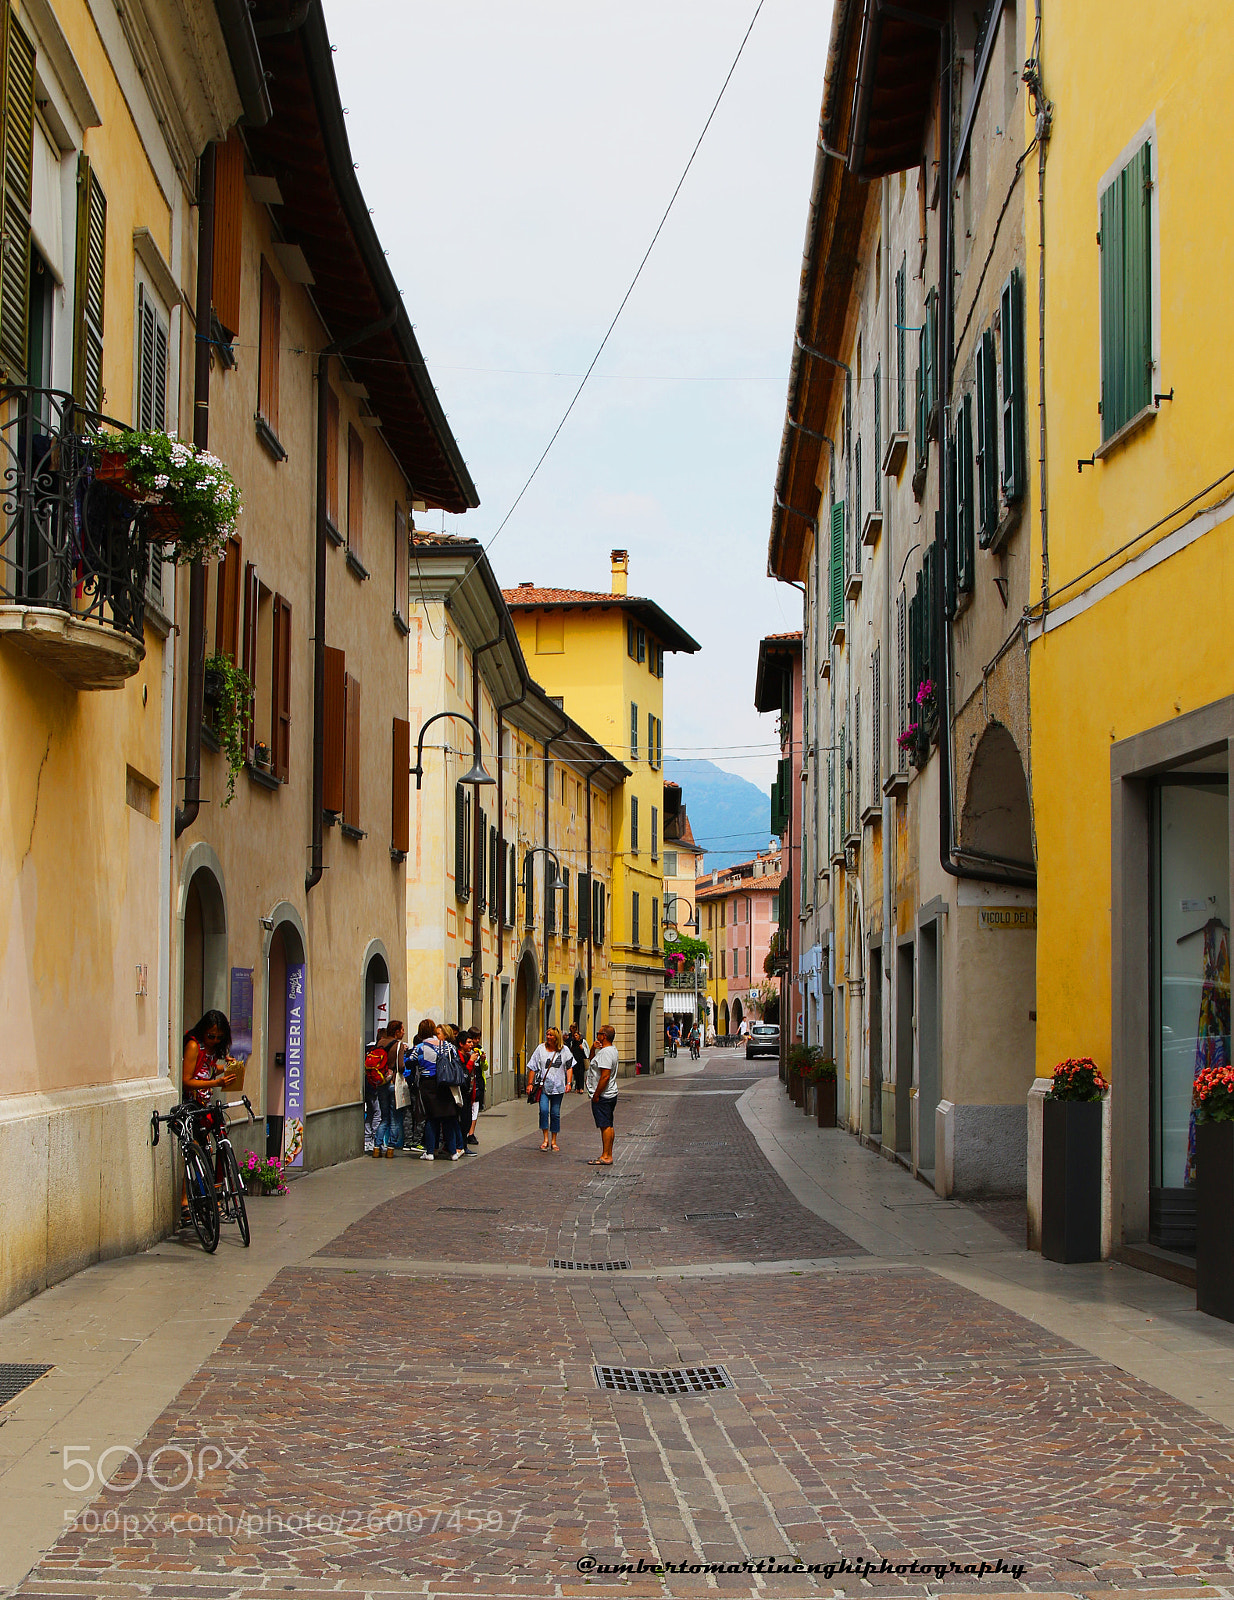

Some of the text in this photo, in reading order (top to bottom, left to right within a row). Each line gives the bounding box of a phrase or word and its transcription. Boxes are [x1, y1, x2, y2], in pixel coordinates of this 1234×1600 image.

[981, 911, 1011, 924] VICOLO
[1014, 911, 1028, 924] DEI
[289, 1006, 301, 1107] PIADINERIA
